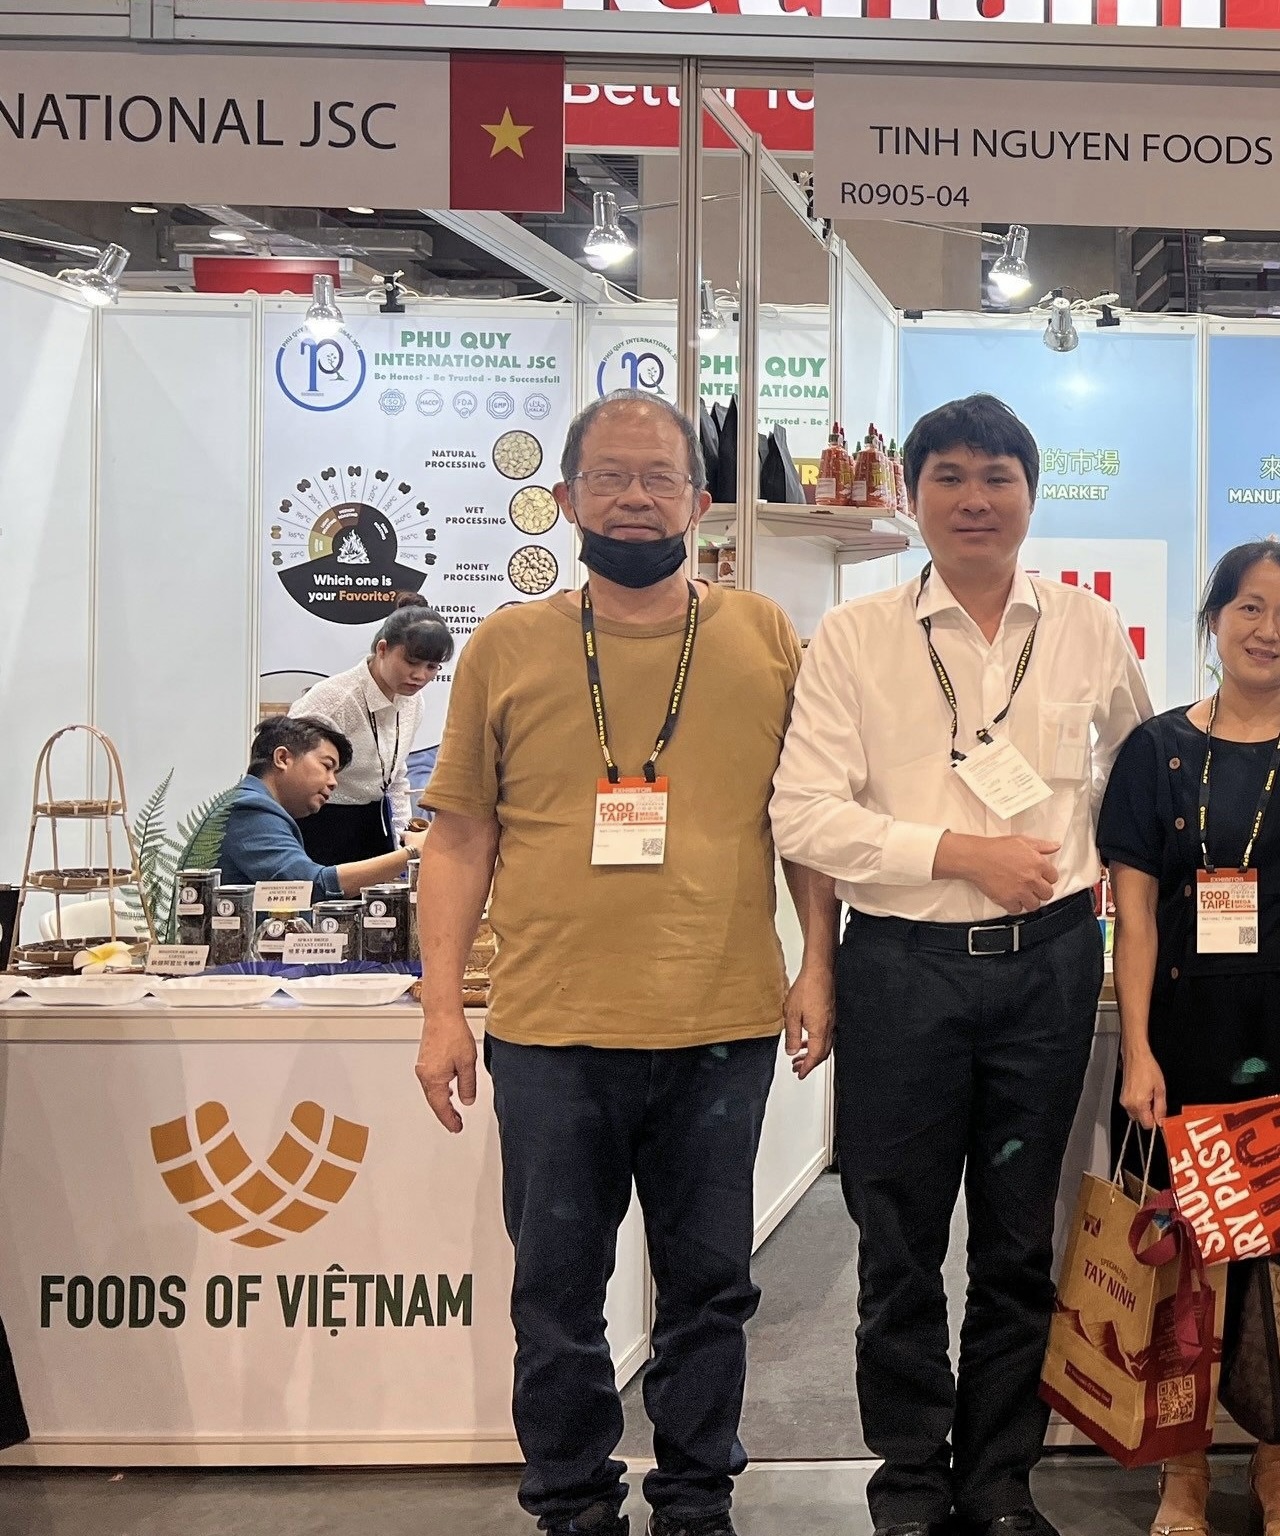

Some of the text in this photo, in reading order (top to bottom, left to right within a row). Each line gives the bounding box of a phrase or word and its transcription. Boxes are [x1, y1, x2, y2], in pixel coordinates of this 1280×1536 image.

[299, 102, 398, 150] JSC
[870, 125, 959, 157] TINH
[972, 128, 1131, 163] NGUYEN
[1142, 133, 1273, 166] FOODS
[841, 182, 970, 208] R0905-04
[400, 331, 512, 350] PHU QUY
[374, 352, 556, 370] INTERNATIONAL JSC
[700, 355, 739, 375] PH
[764, 356, 827, 378] QUY
[374, 372, 560, 385] Be Honest Be Trusted Be Successfull
[384, 398, 399, 407] ISO
[456, 398, 473, 407] FDA
[493, 401, 508, 410] GMP
[764, 417, 822, 426] Trusted Be
[431, 450, 477, 458] NATURAL
[425, 460, 486, 470] PROCESSING
[1039, 448, 1121, 476] 的市場
[1042, 484, 1109, 500] MARKET
[465, 506, 484, 514] WET
[445, 516, 506, 526] PROCESSING
[455, 562, 489, 571] HONEY
[313, 573, 392, 587] Which one is
[443, 573, 505, 583] PROCESSING
[308, 590, 397, 603] your Favorite?
[431, 605, 476, 613] AEROBIC
[600, 803, 635, 813] FOOD
[600, 812, 639, 822] TAIPEI
[1200, 890, 1230, 900] FOOD
[1201, 899, 1234, 909] TAIPEI
[1185, 1115, 1251, 1211] PAST
[1170, 1148, 1226, 1258] SAUCE
[1083, 1259, 1138, 1313] TAY NINH
[41, 1263, 474, 1337] FOODS OF VIỆTNAM
